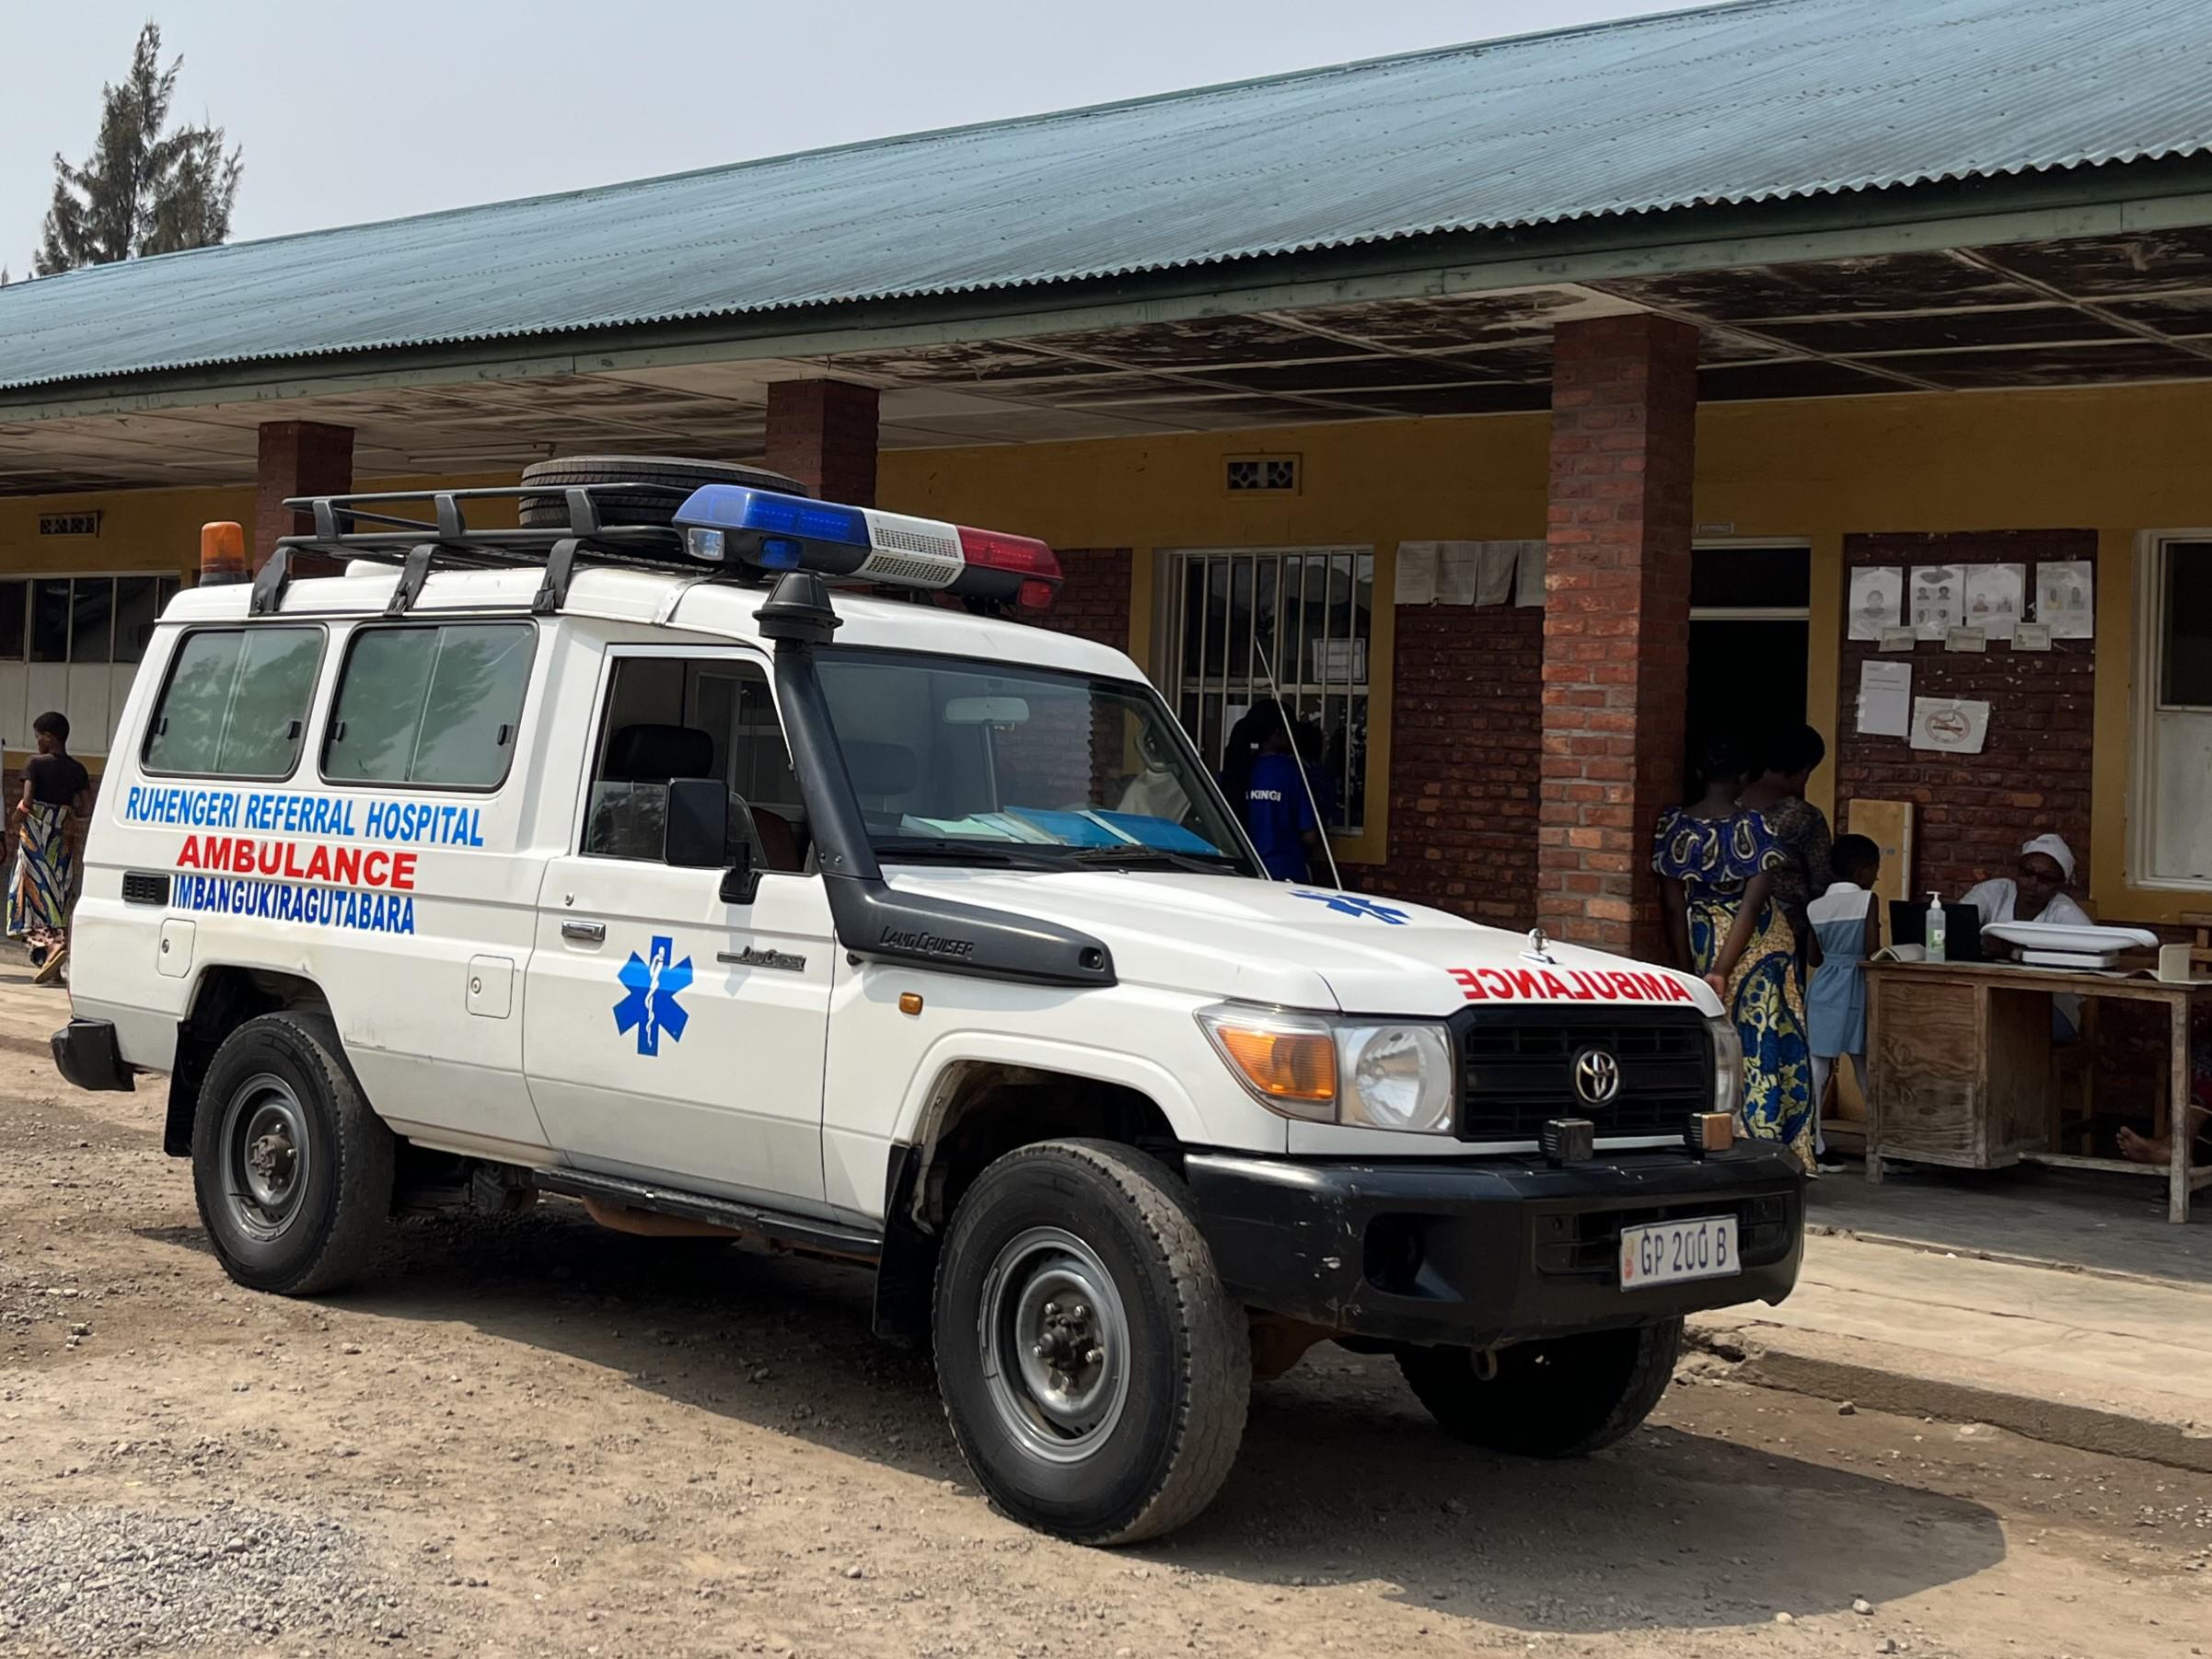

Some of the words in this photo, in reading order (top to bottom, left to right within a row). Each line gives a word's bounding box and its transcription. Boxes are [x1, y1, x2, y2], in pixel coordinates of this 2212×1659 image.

[126, 786, 240, 829] RUHENGERI
[245, 794, 355, 836] REFERRAL
[365, 802, 484, 847] HOSPITAL
[177, 834, 418, 889] AMBULANCE
[172, 874, 414, 934] IMBANGUKIRAGUTABARA
[1641, 1232, 1664, 1276] GP
[1673, 1229, 1708, 1272] 200
[1716, 1226, 1727, 1268] B
